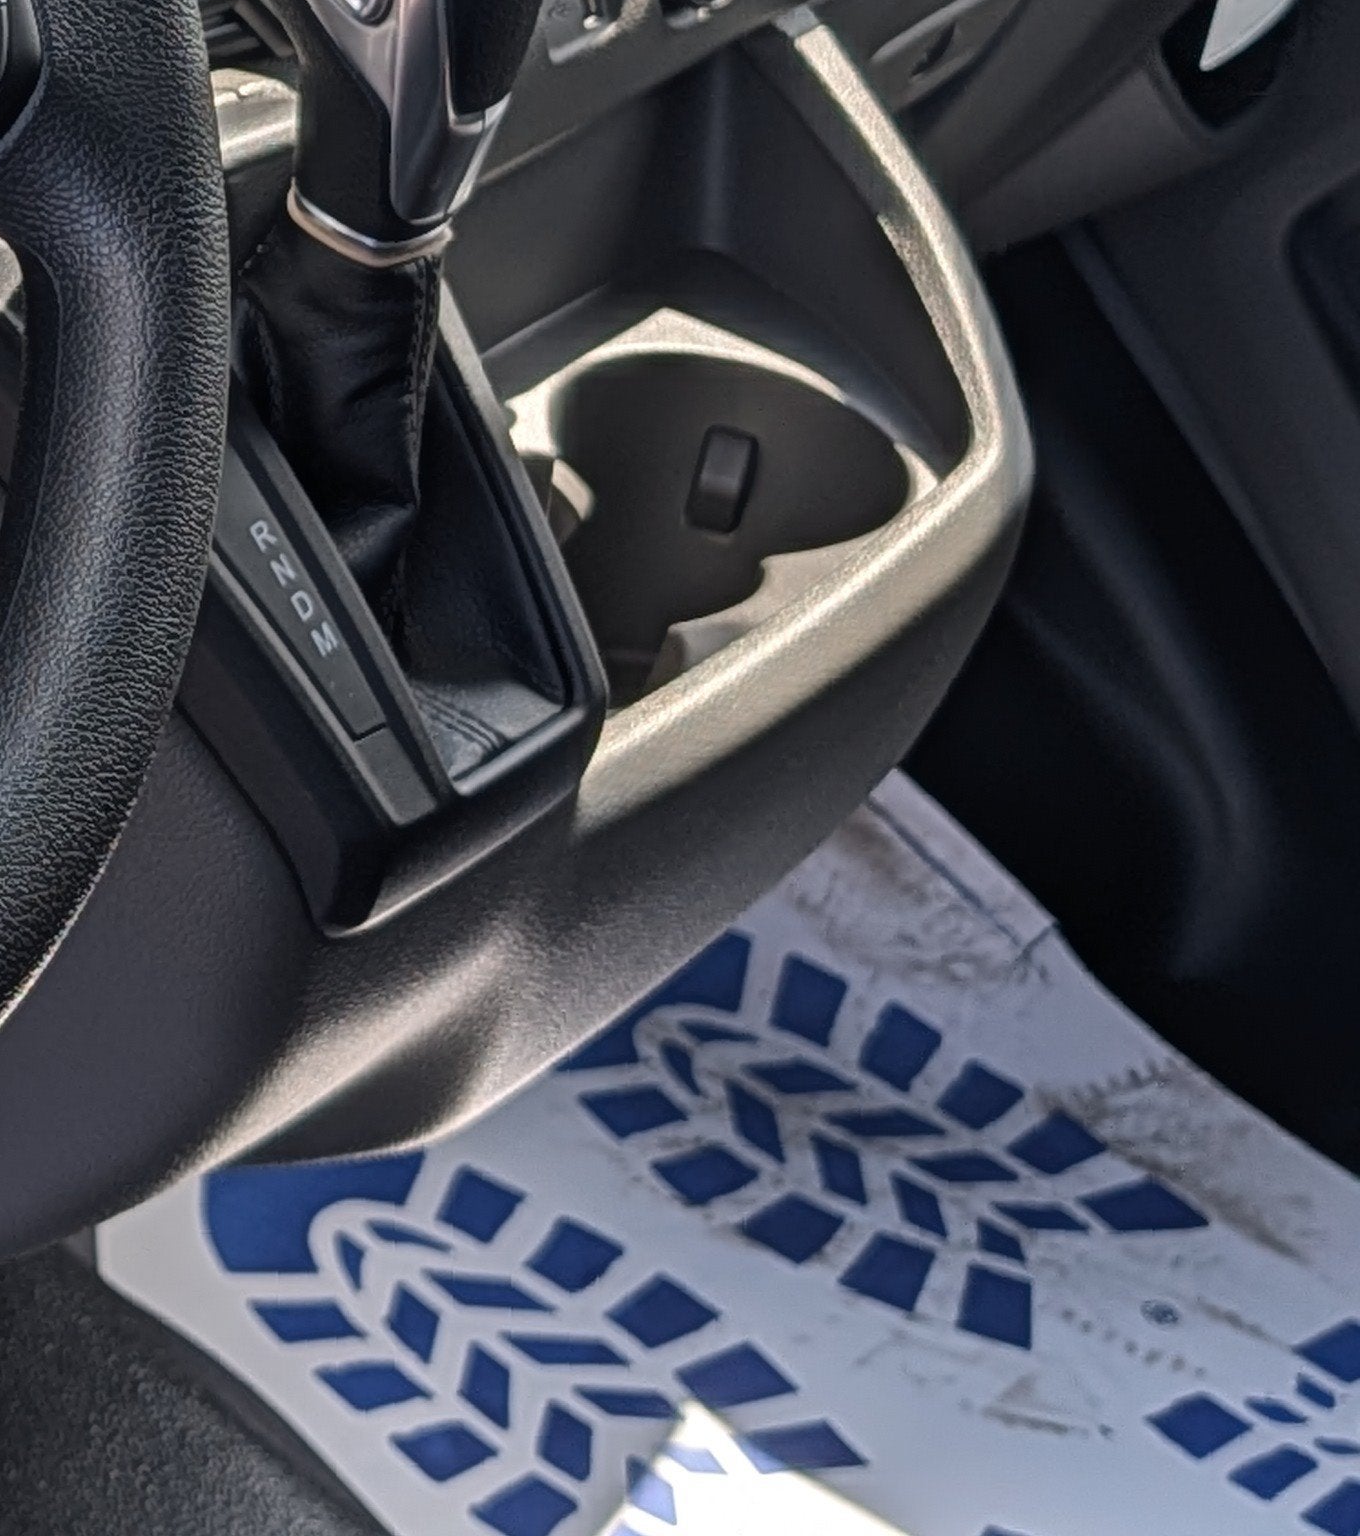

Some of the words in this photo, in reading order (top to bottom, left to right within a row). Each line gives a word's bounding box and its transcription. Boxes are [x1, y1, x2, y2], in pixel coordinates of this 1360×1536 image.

[249, 520, 277, 553] R
[270, 553, 298, 586] N
[290, 590, 316, 622] D
[311, 622, 338, 657] M
